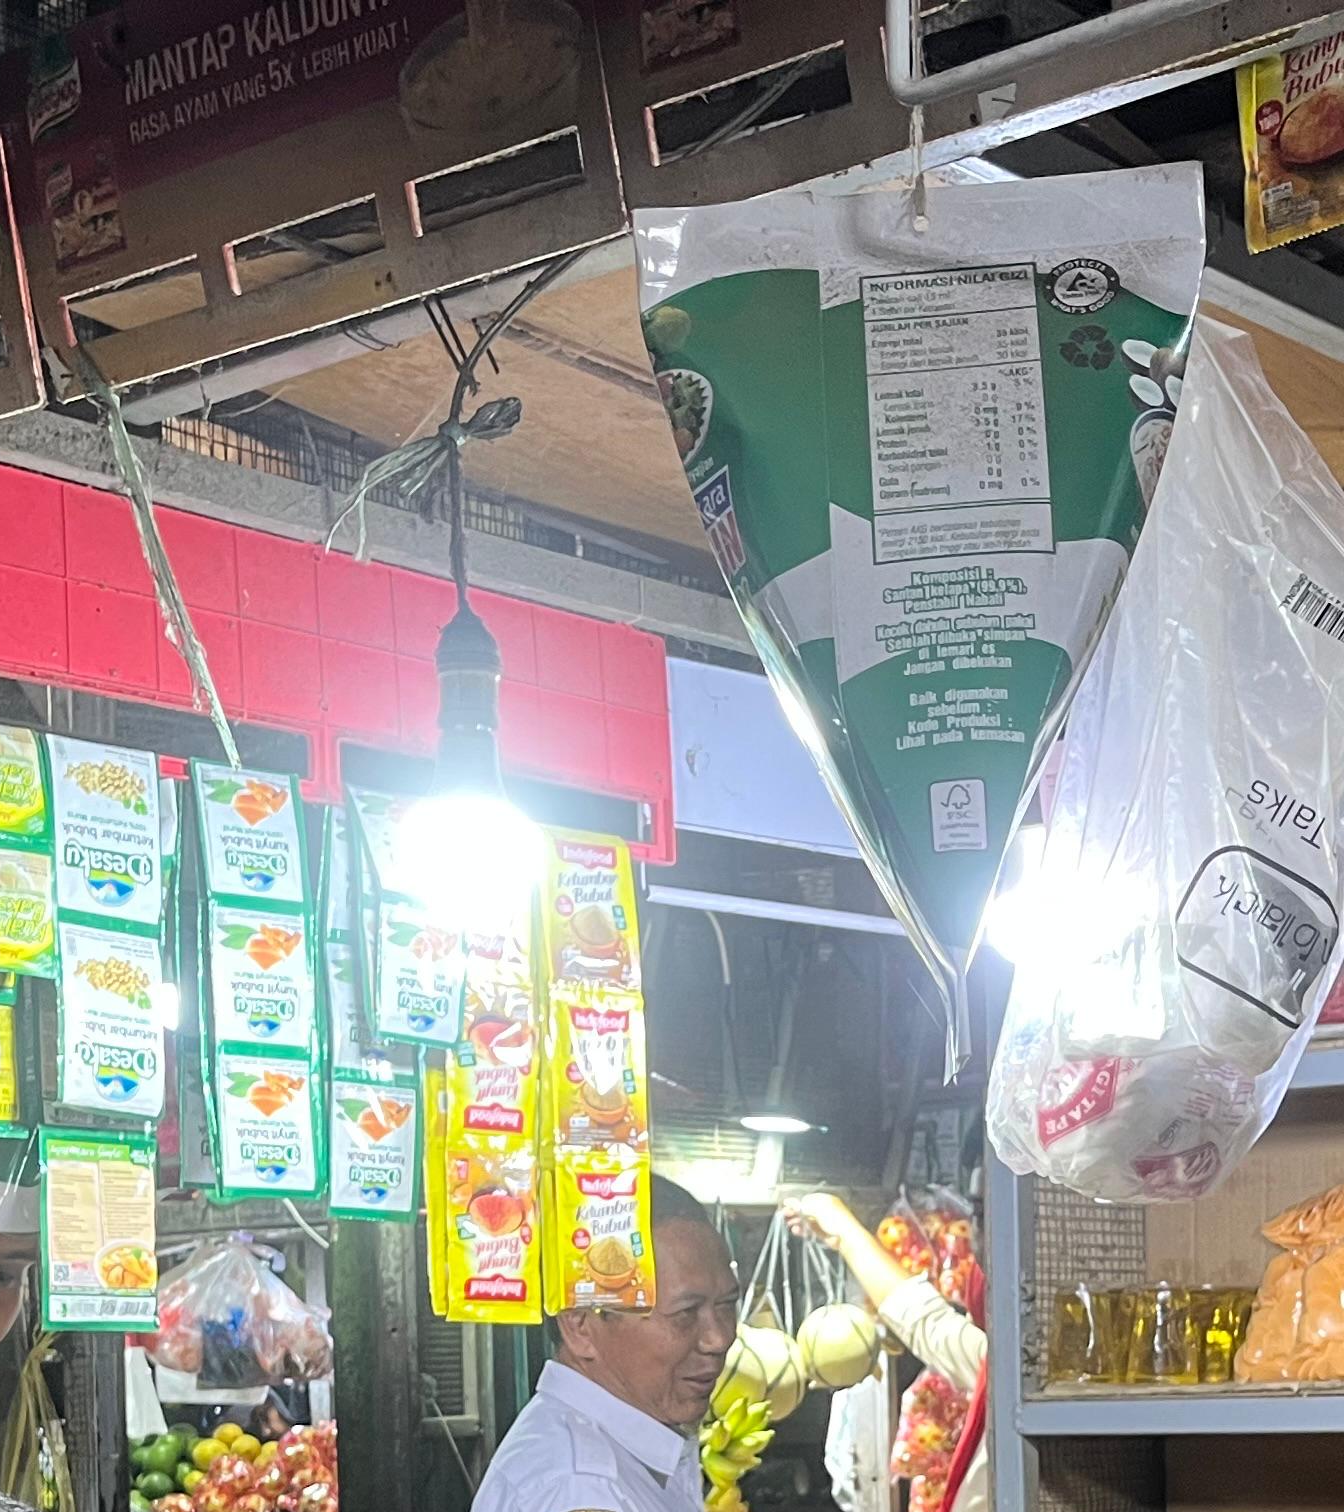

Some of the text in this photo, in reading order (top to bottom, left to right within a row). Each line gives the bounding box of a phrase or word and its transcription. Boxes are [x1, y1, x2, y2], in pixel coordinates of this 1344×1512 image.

[125, 24, 237, 106] MANTAP
[130, 117, 171, 145] RASA
[174, 97, 219, 128] AYAM
[220, 77, 266, 109] YANG
[303, 40, 349, 80] LEBIH
[353, 25, 399, 61] KUAT
[869, 269, 1029, 293] INFORMASI NILAI GIZI
[912, 567, 981, 585] Komposisi
[983, 628, 1026, 643] simpan
[936, 643, 974, 658] lemari
[982, 643, 995, 654] es
[1248, 780, 1327, 849] Talks
[62, 822, 154, 850] ketumbar bubuk
[220, 834, 290, 853] kunyit bubuk
[63, 840, 153, 886] Desaku
[224, 847, 288, 876] Desaku
[231, 980, 265, 994] bubuk
[233, 994, 295, 1021] Desaku
[74, 1040, 156, 1079] Desaku
[469, 1110, 520, 1129] Indofood
[236, 1127, 270, 1141] bubuk
[240, 1140, 301, 1166] Desaku
[347, 1150, 376, 1164] bubuk
[348, 1164, 402, 1186] Desaku
[468, 1278, 522, 1299] Indofood
